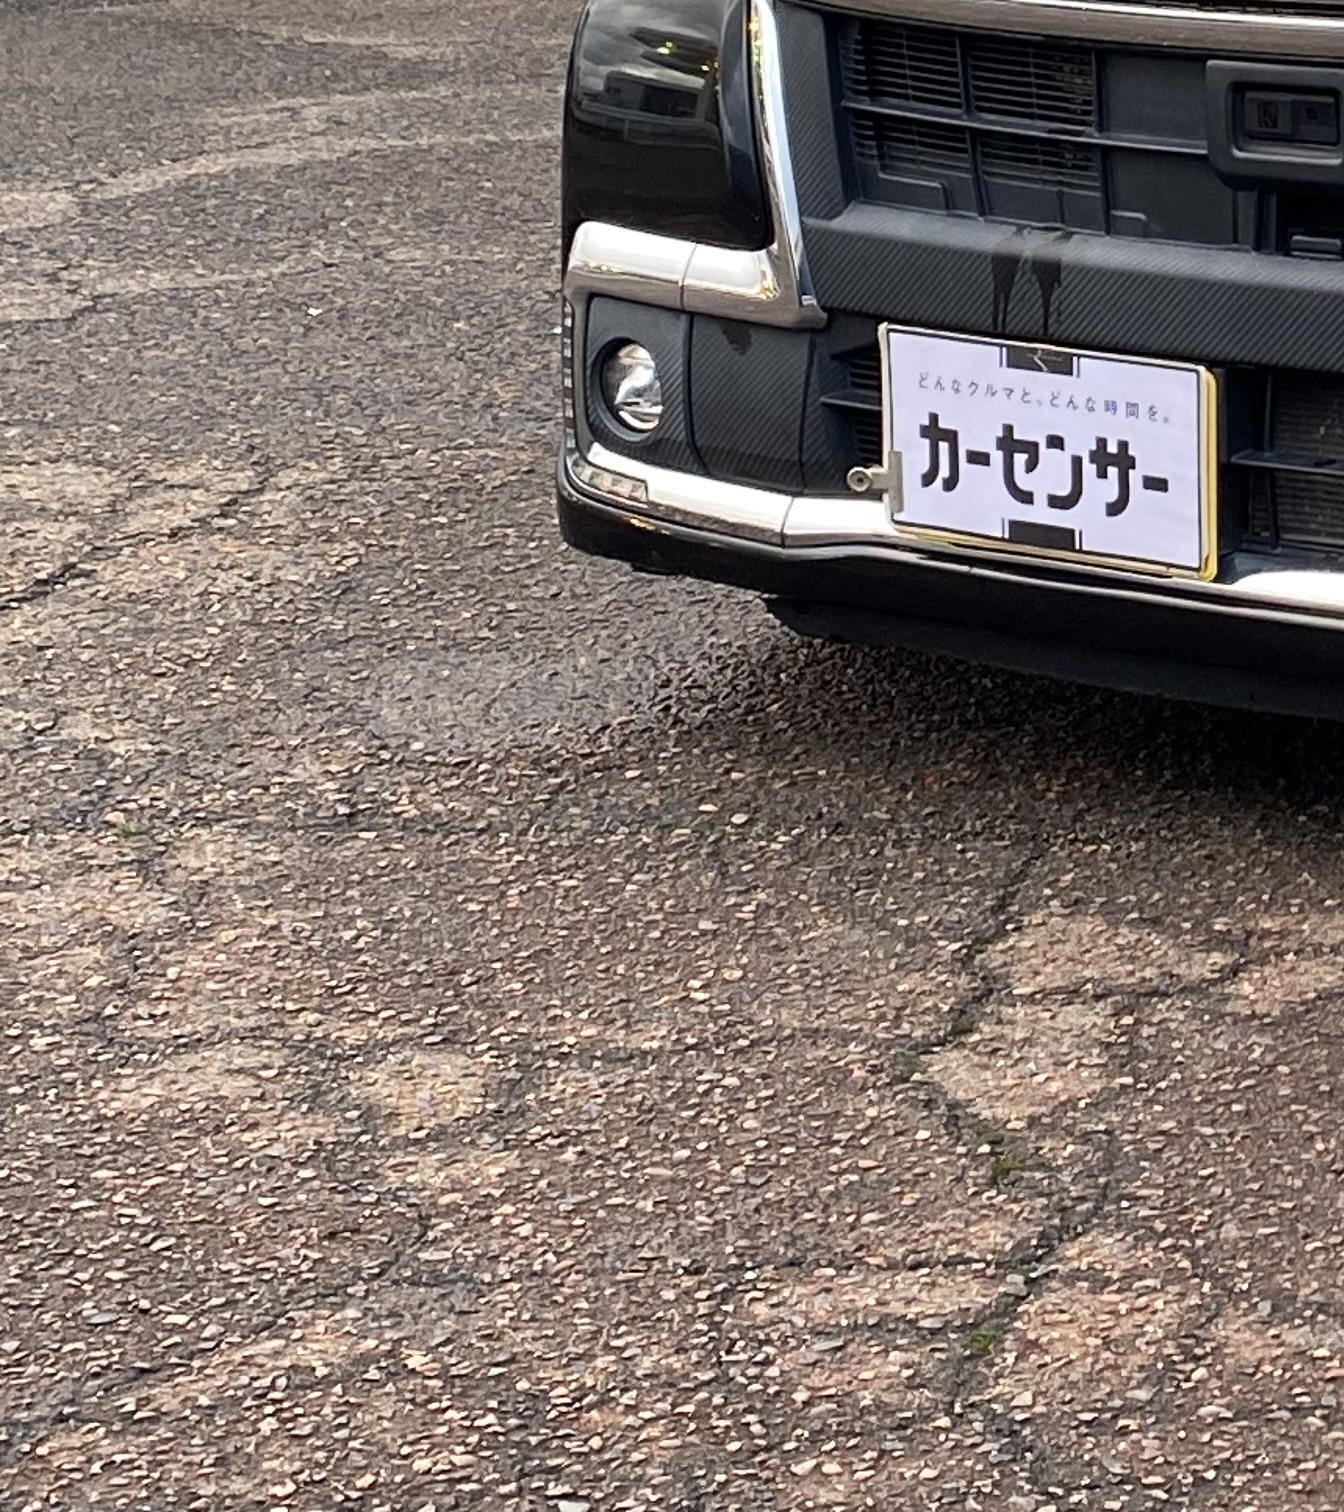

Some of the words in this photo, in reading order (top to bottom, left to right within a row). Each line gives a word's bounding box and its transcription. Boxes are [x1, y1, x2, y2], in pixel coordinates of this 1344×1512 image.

[919, 411, 1170, 518] カーセンサー
